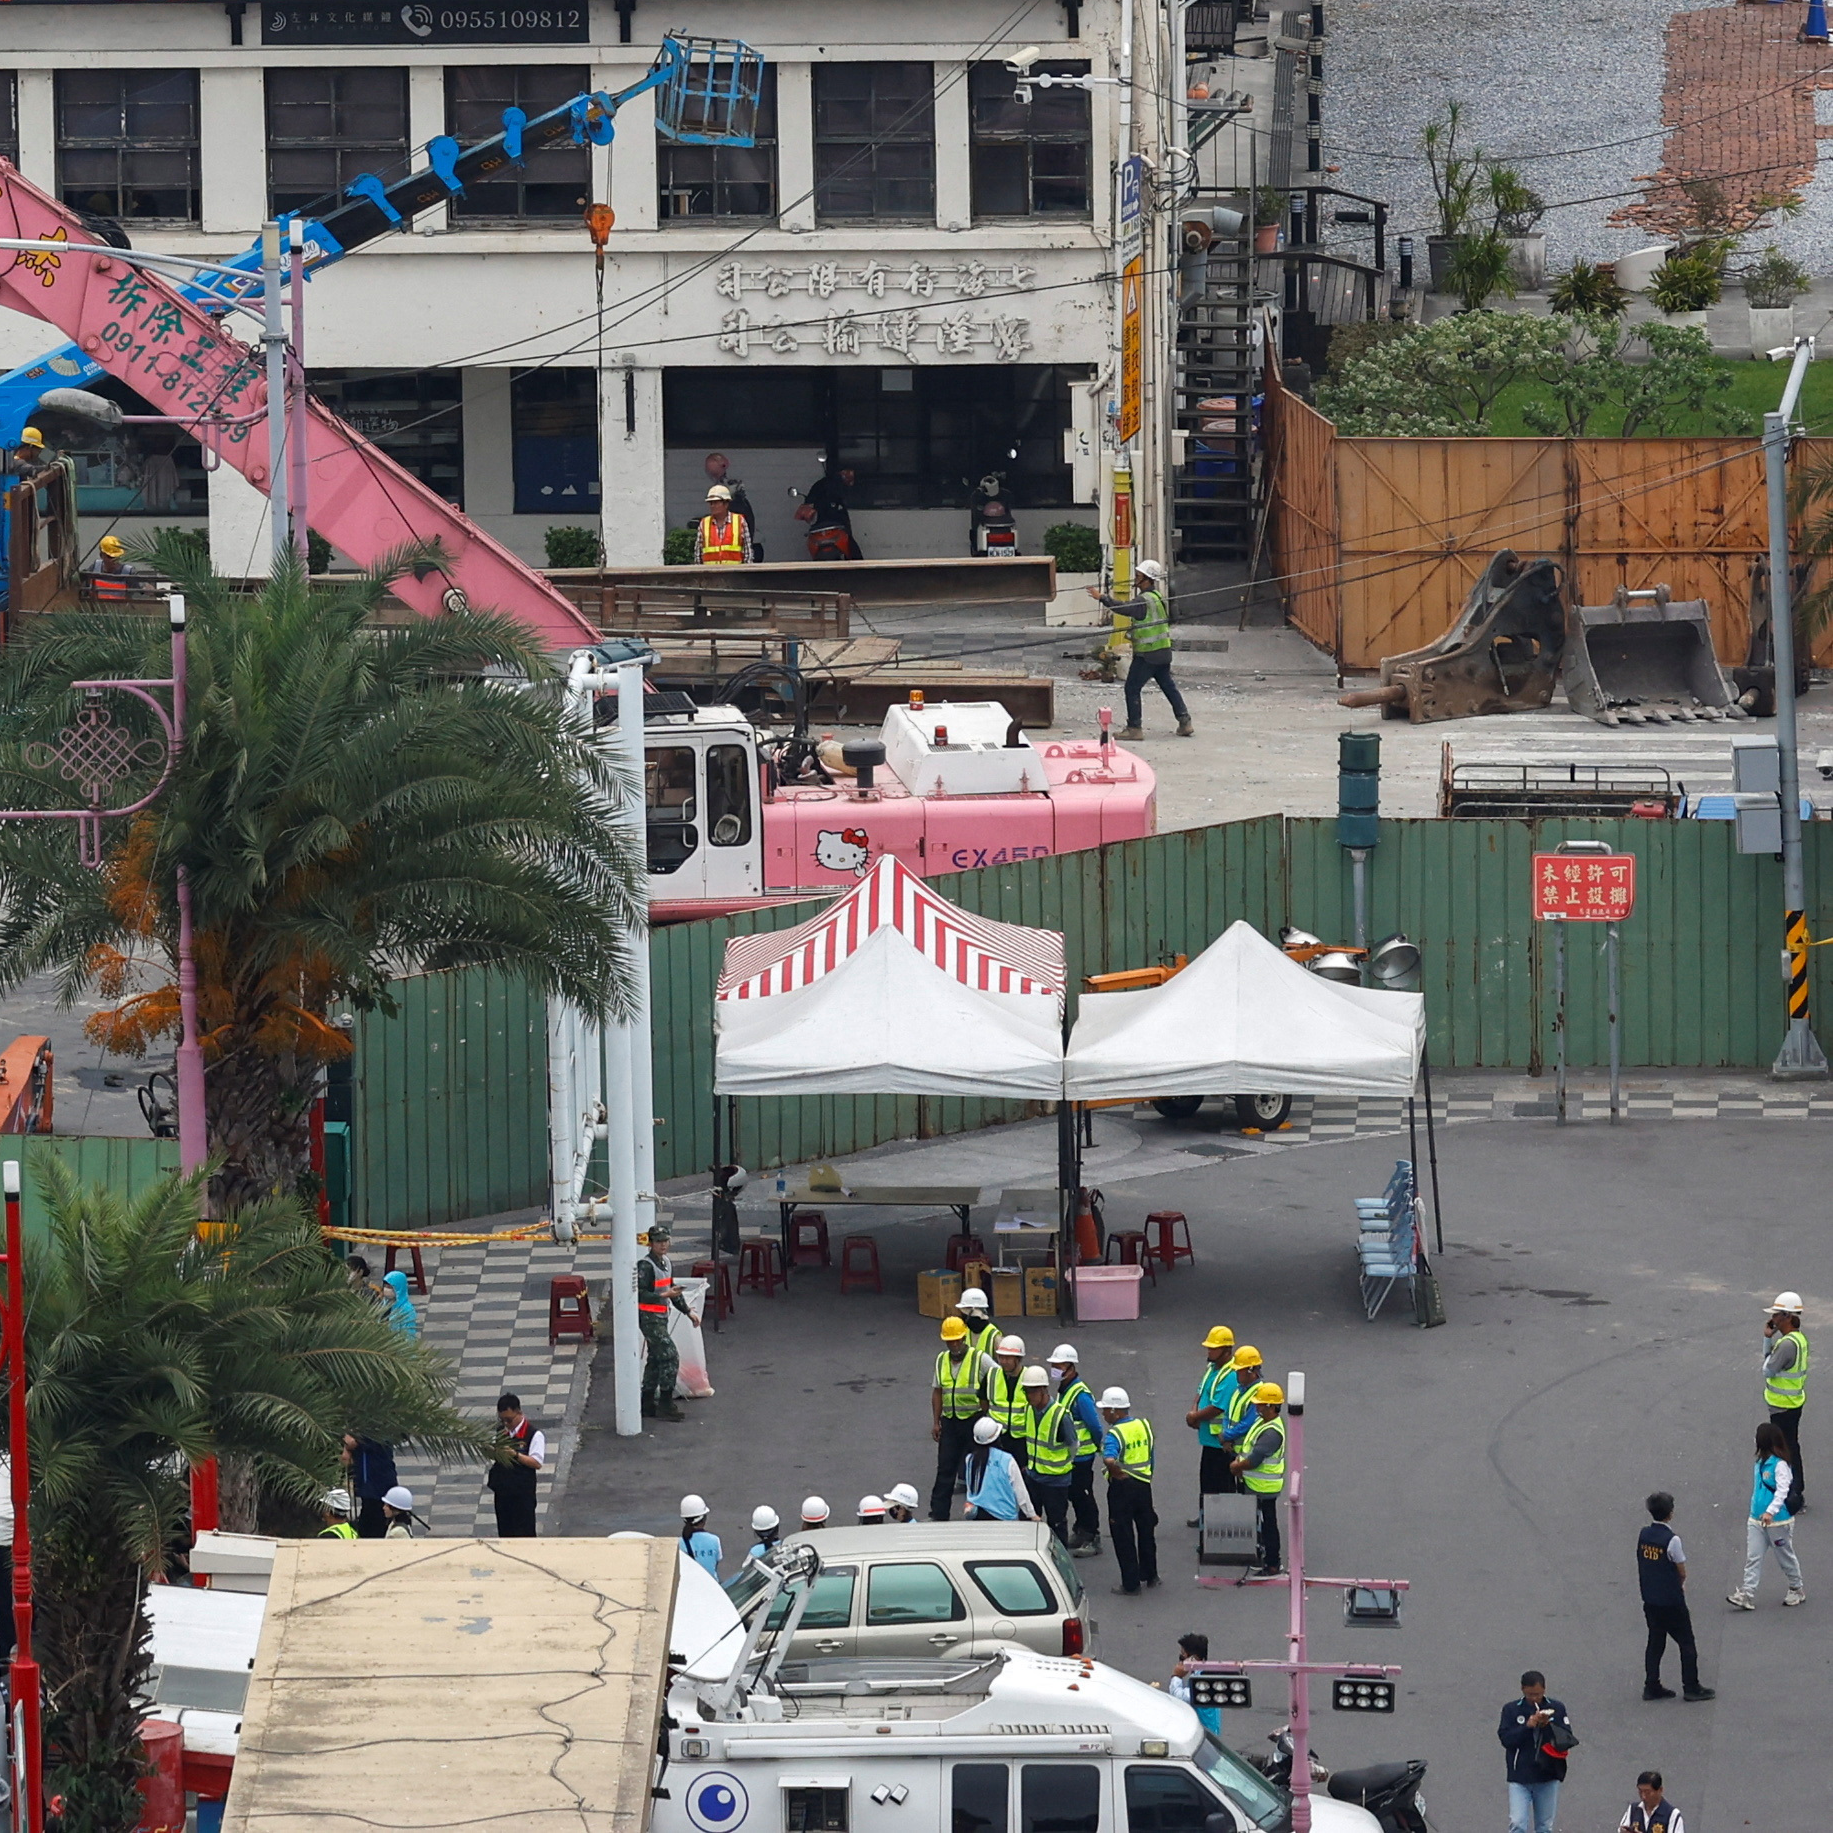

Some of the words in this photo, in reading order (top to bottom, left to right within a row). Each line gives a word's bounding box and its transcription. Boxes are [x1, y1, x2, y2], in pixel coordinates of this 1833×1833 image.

[440, 9, 580, 31] 0955109812
[1123, 163, 1135, 203] P
[98, 319, 249, 445] 0911-81269
[1540, 863, 1629, 884] 未經許可
[1541, 885, 1629, 907] 禁止設攤
[1643, 1549, 1659, 1561] CID
